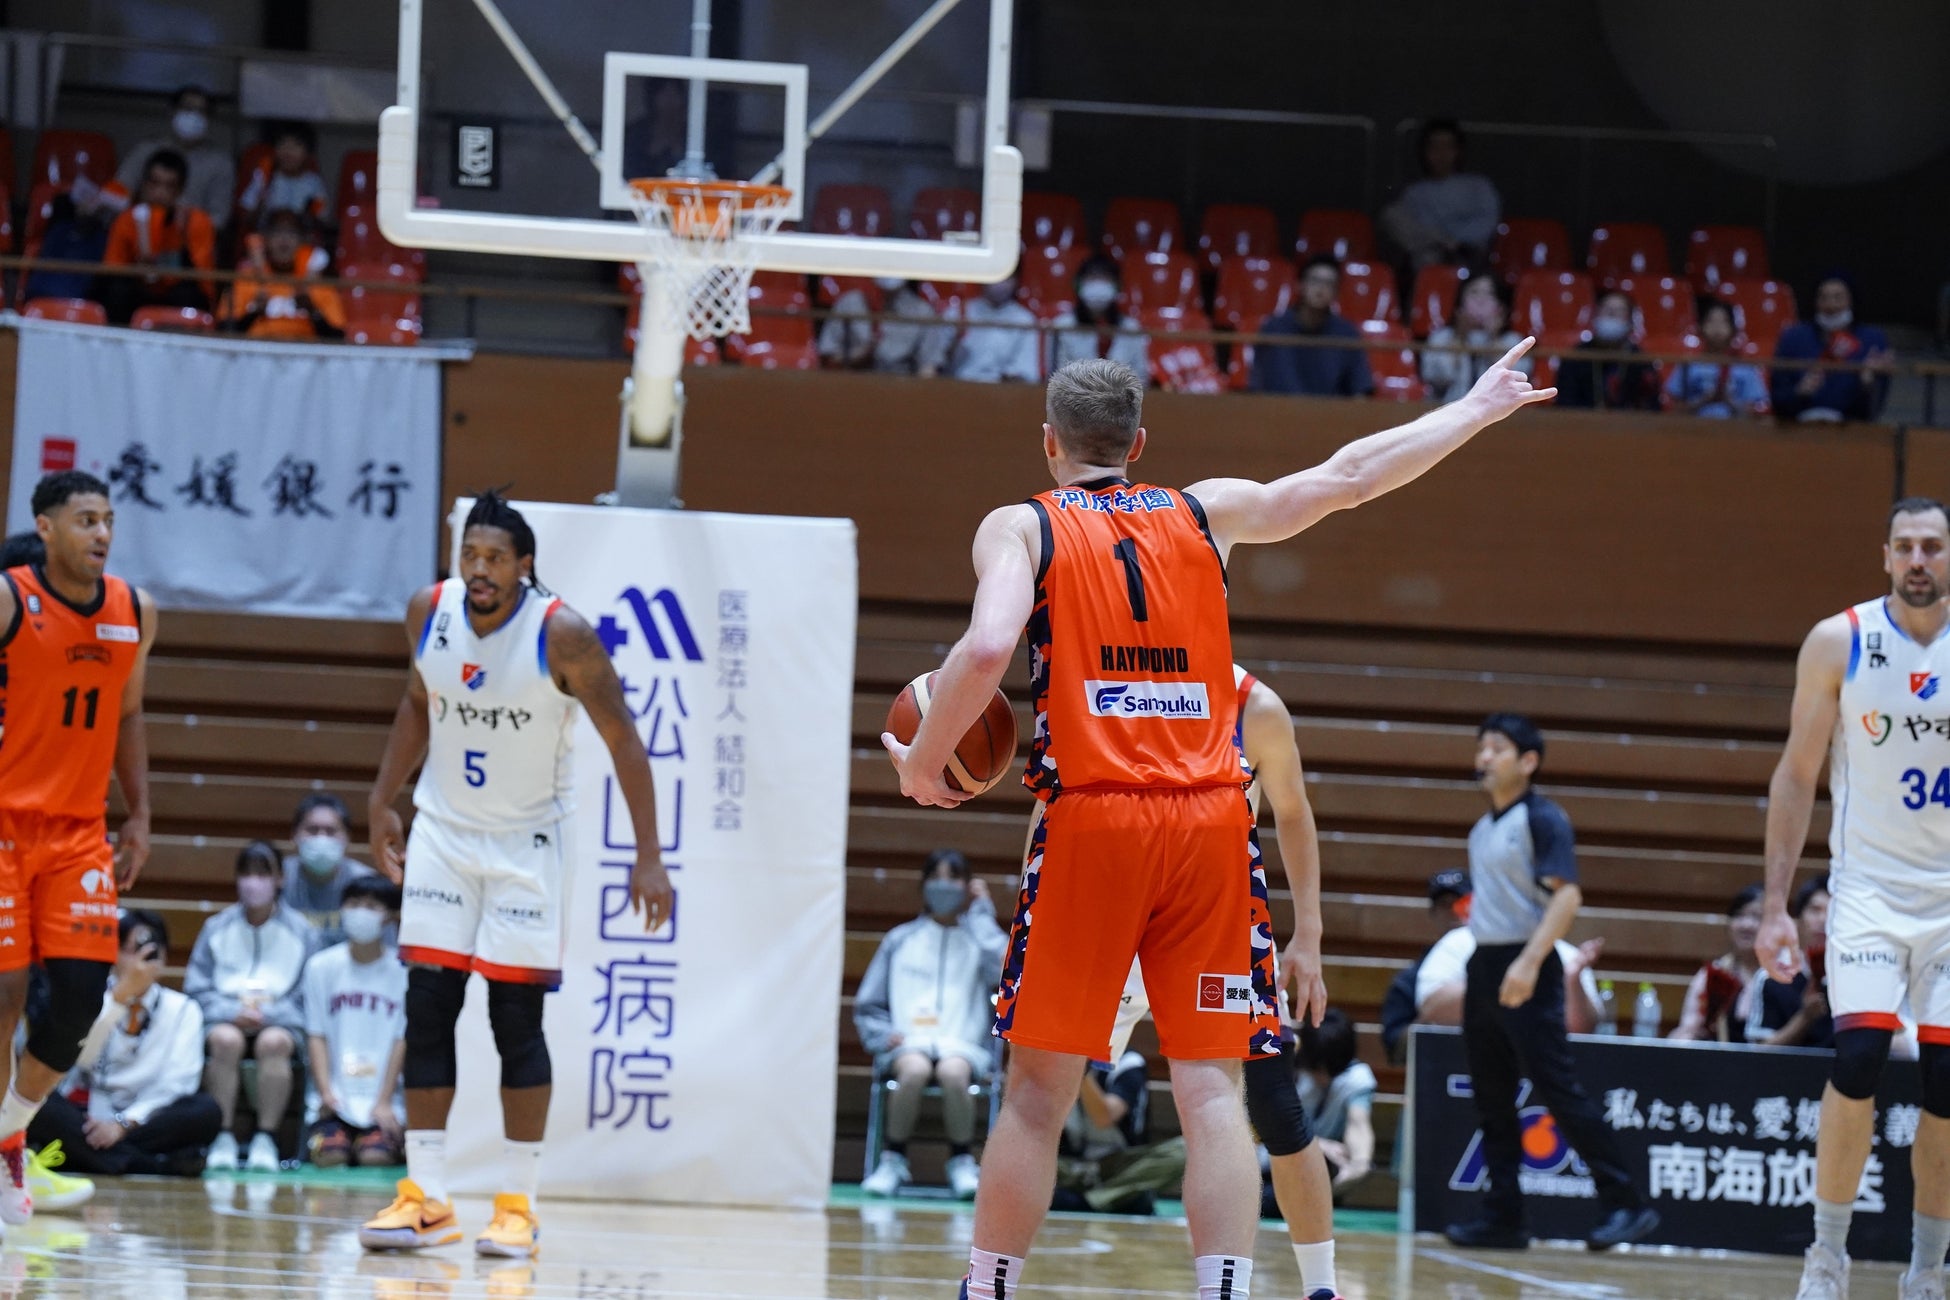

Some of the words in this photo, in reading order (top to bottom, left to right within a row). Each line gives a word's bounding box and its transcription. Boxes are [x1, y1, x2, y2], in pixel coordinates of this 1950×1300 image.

[107, 441, 412, 520] 愛媛銀行
[1051, 488, 1177, 517] 河原学園
[1112, 536, 1149, 622] 1
[715, 588, 750, 724] 医療法人
[1100, 644, 1189, 673] HAYMOND
[62, 686, 100, 730] 11
[456, 701, 531, 731] やずや
[1124, 694, 1203, 715] Sanpuku
[463, 749, 488, 788] 5
[1900, 766, 1950, 811] 34
[587, 676, 688, 1132] 松山西病院
